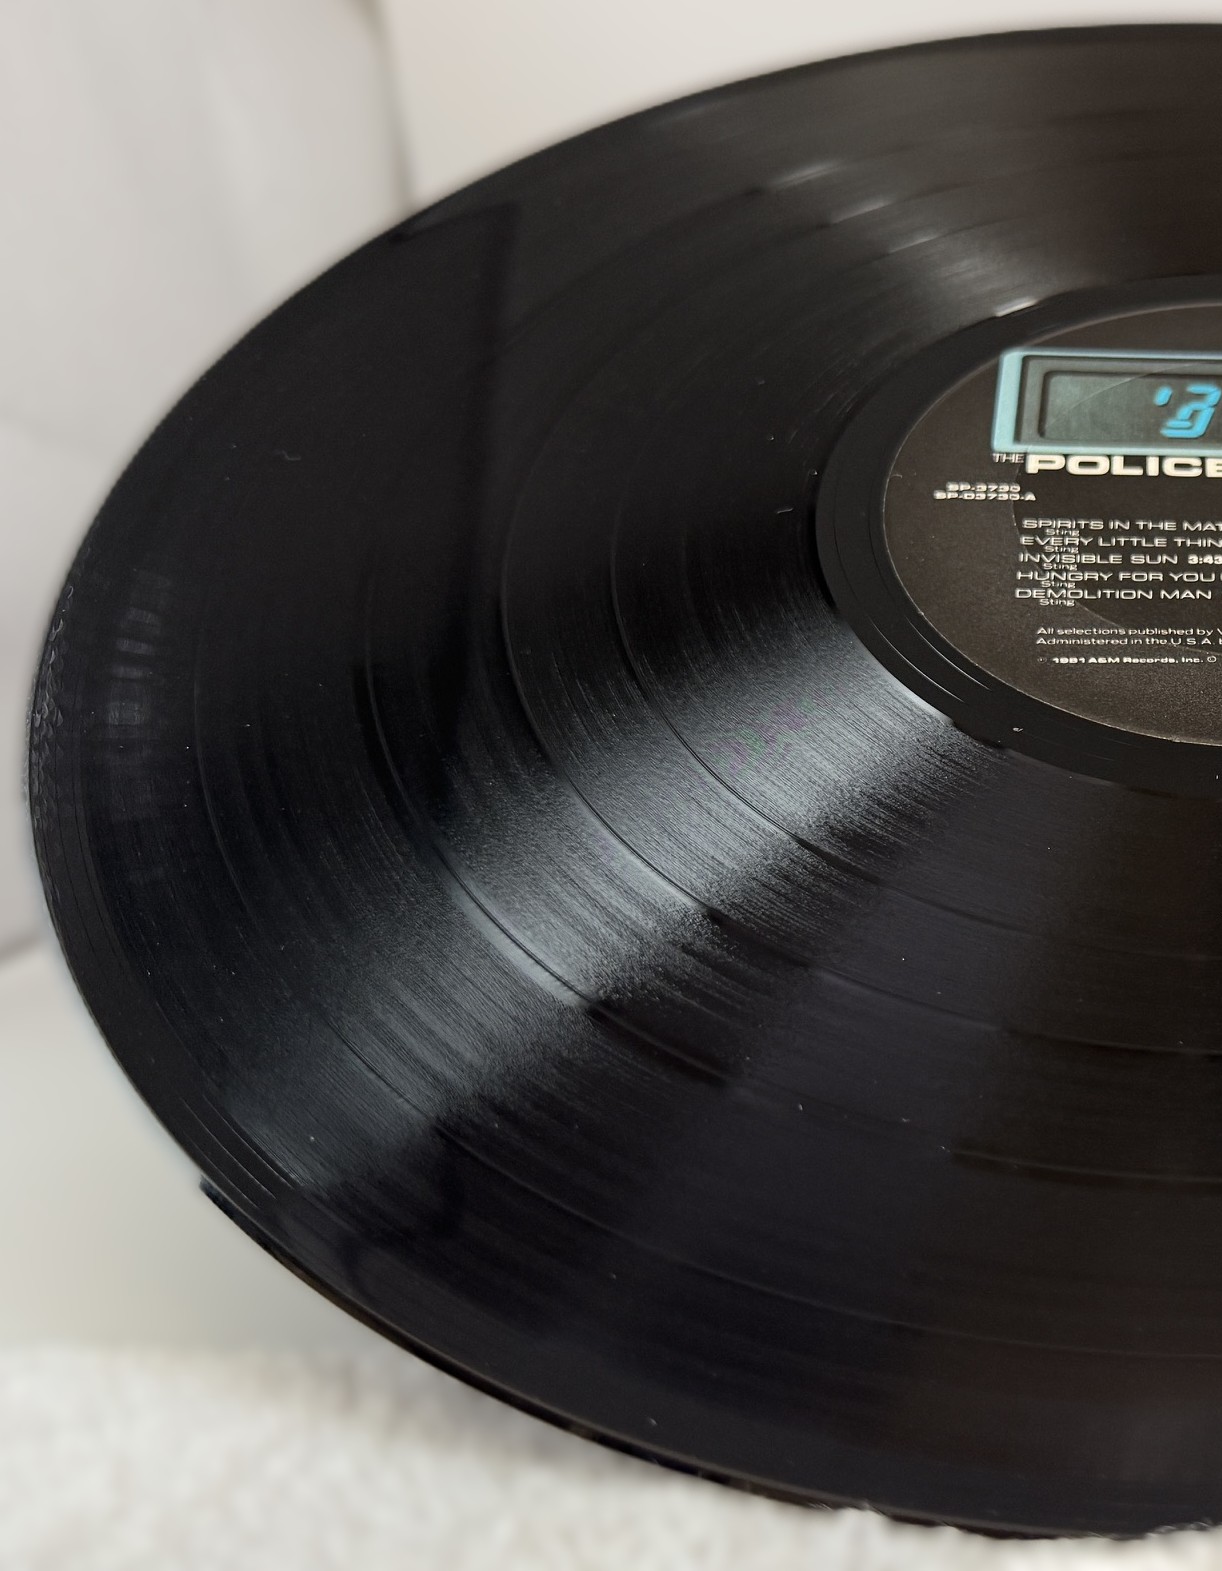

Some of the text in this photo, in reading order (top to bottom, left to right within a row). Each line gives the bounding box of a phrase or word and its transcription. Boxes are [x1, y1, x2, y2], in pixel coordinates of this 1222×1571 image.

[992, 453, 1024, 463] THE
[946, 482, 1020, 492] SP-3730
[1022, 518, 1104, 530] SPIRITS
[1109, 519, 1130, 530] IN
[1135, 520, 1177, 531] THE
[1044, 528, 1080, 537] Sting
[1020, 536, 1093, 546] EVERY
[1098, 536, 1168, 547] LITTLE
[1043, 545, 1079, 554] Sting
[1018, 552, 1122, 564] INVISIBLE
[1130, 553, 1178, 565] SUN
[1042, 562, 1078, 572] Sting
[1016, 570, 1113, 582] HUNGRY
[1118, 571, 1164, 582] FOR
[1169, 572, 1216, 583] YOU
[1040, 580, 1076, 589] Sting
[1014, 588, 1153, 600] DEMOLITION
[1160, 588, 1213, 600] MAN
[1039, 598, 1075, 607] Sting
[1036, 627, 1054, 635] All
[1057, 627, 1126, 636] selections
[1128, 627, 1194, 637] published
[1196, 627, 1213, 637] by
[1036, 637, 1128, 646] Administered
[1130, 637, 1143, 645] in
[1146, 637, 1168, 645] the
[1052, 656, 1086, 664] 1981
[1088, 656, 1120, 664] A&M
[1181, 656, 1204, 664] Inc.
